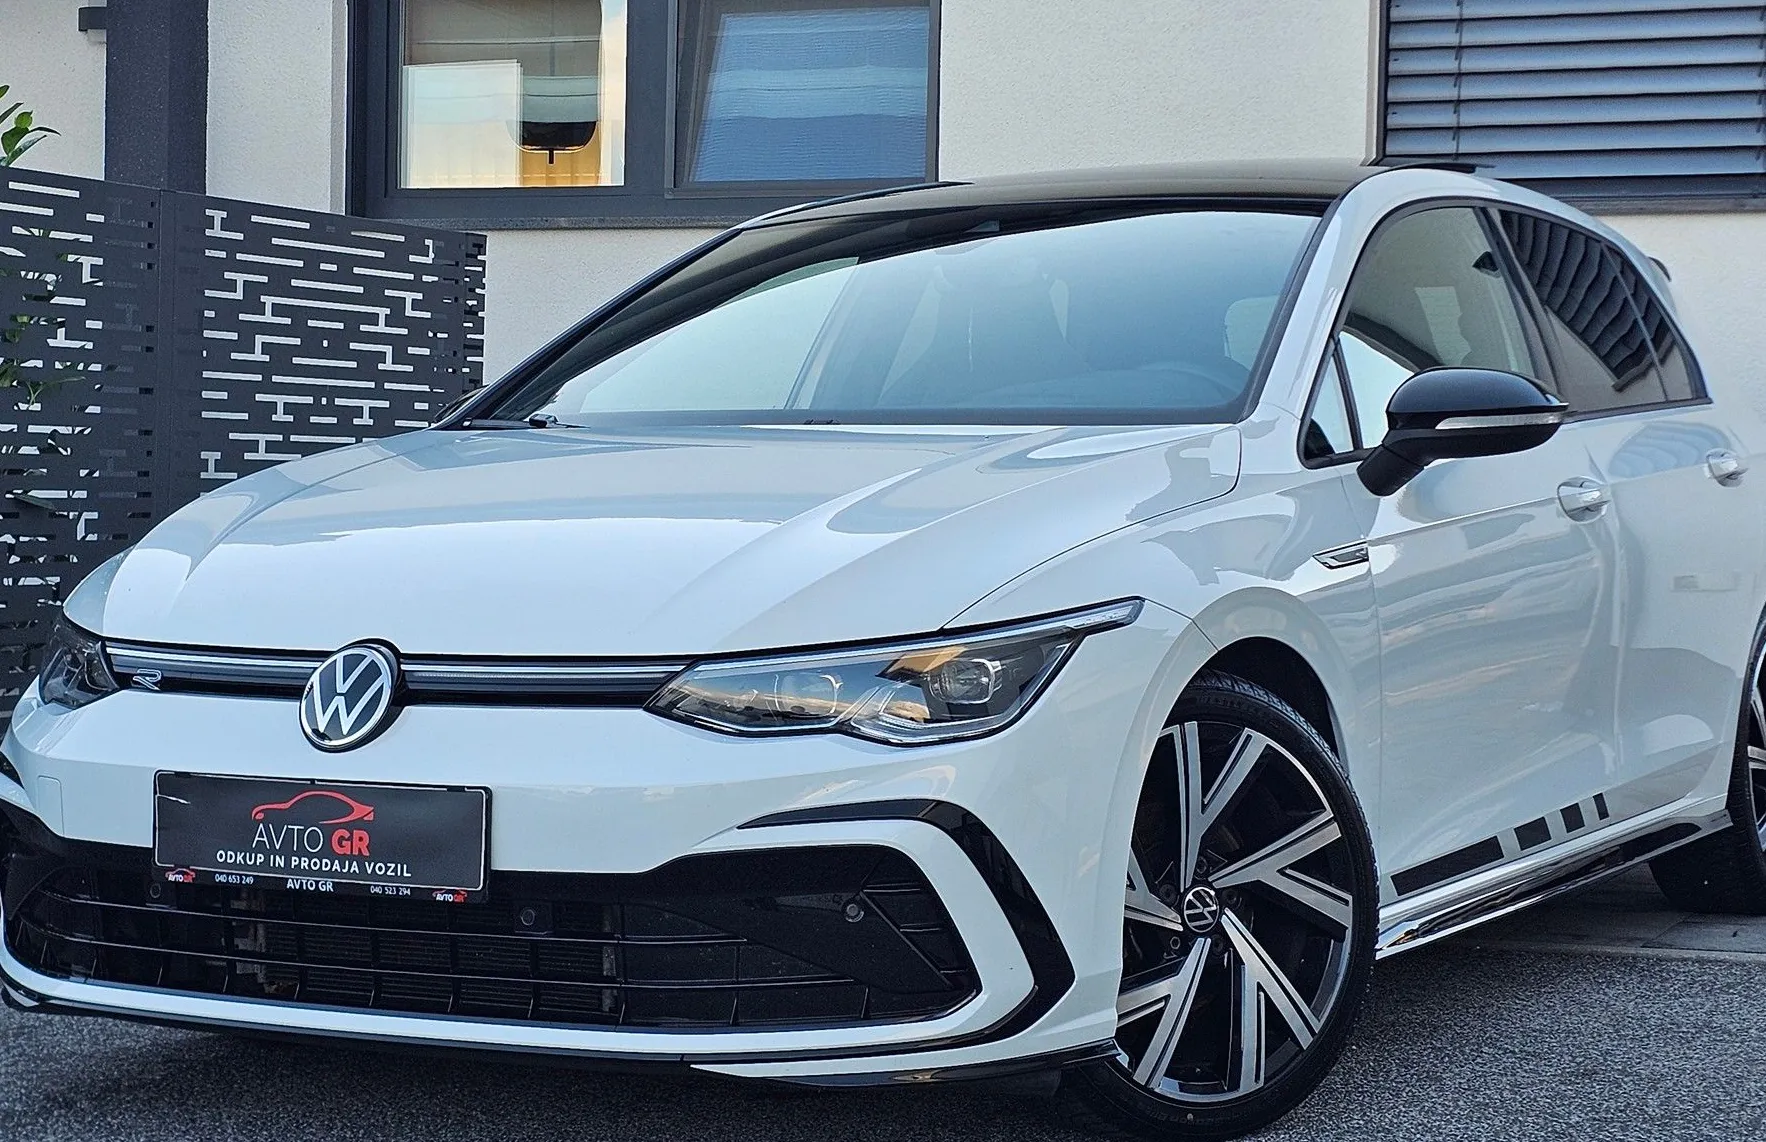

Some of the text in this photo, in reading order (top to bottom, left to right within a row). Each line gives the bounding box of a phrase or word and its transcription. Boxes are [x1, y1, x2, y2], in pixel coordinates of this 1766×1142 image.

[132, 669, 162, 691] R
[304, 646, 391, 744] VW
[252, 822, 370, 856] AVTO GR
[216, 849, 412, 878] ODKUP IN PRODAJA VOZIL
[214, 873, 254, 885] 040 653 249
[286, 878, 334, 892] AVTO GR
[370, 885, 411, 896] 040 523 294
